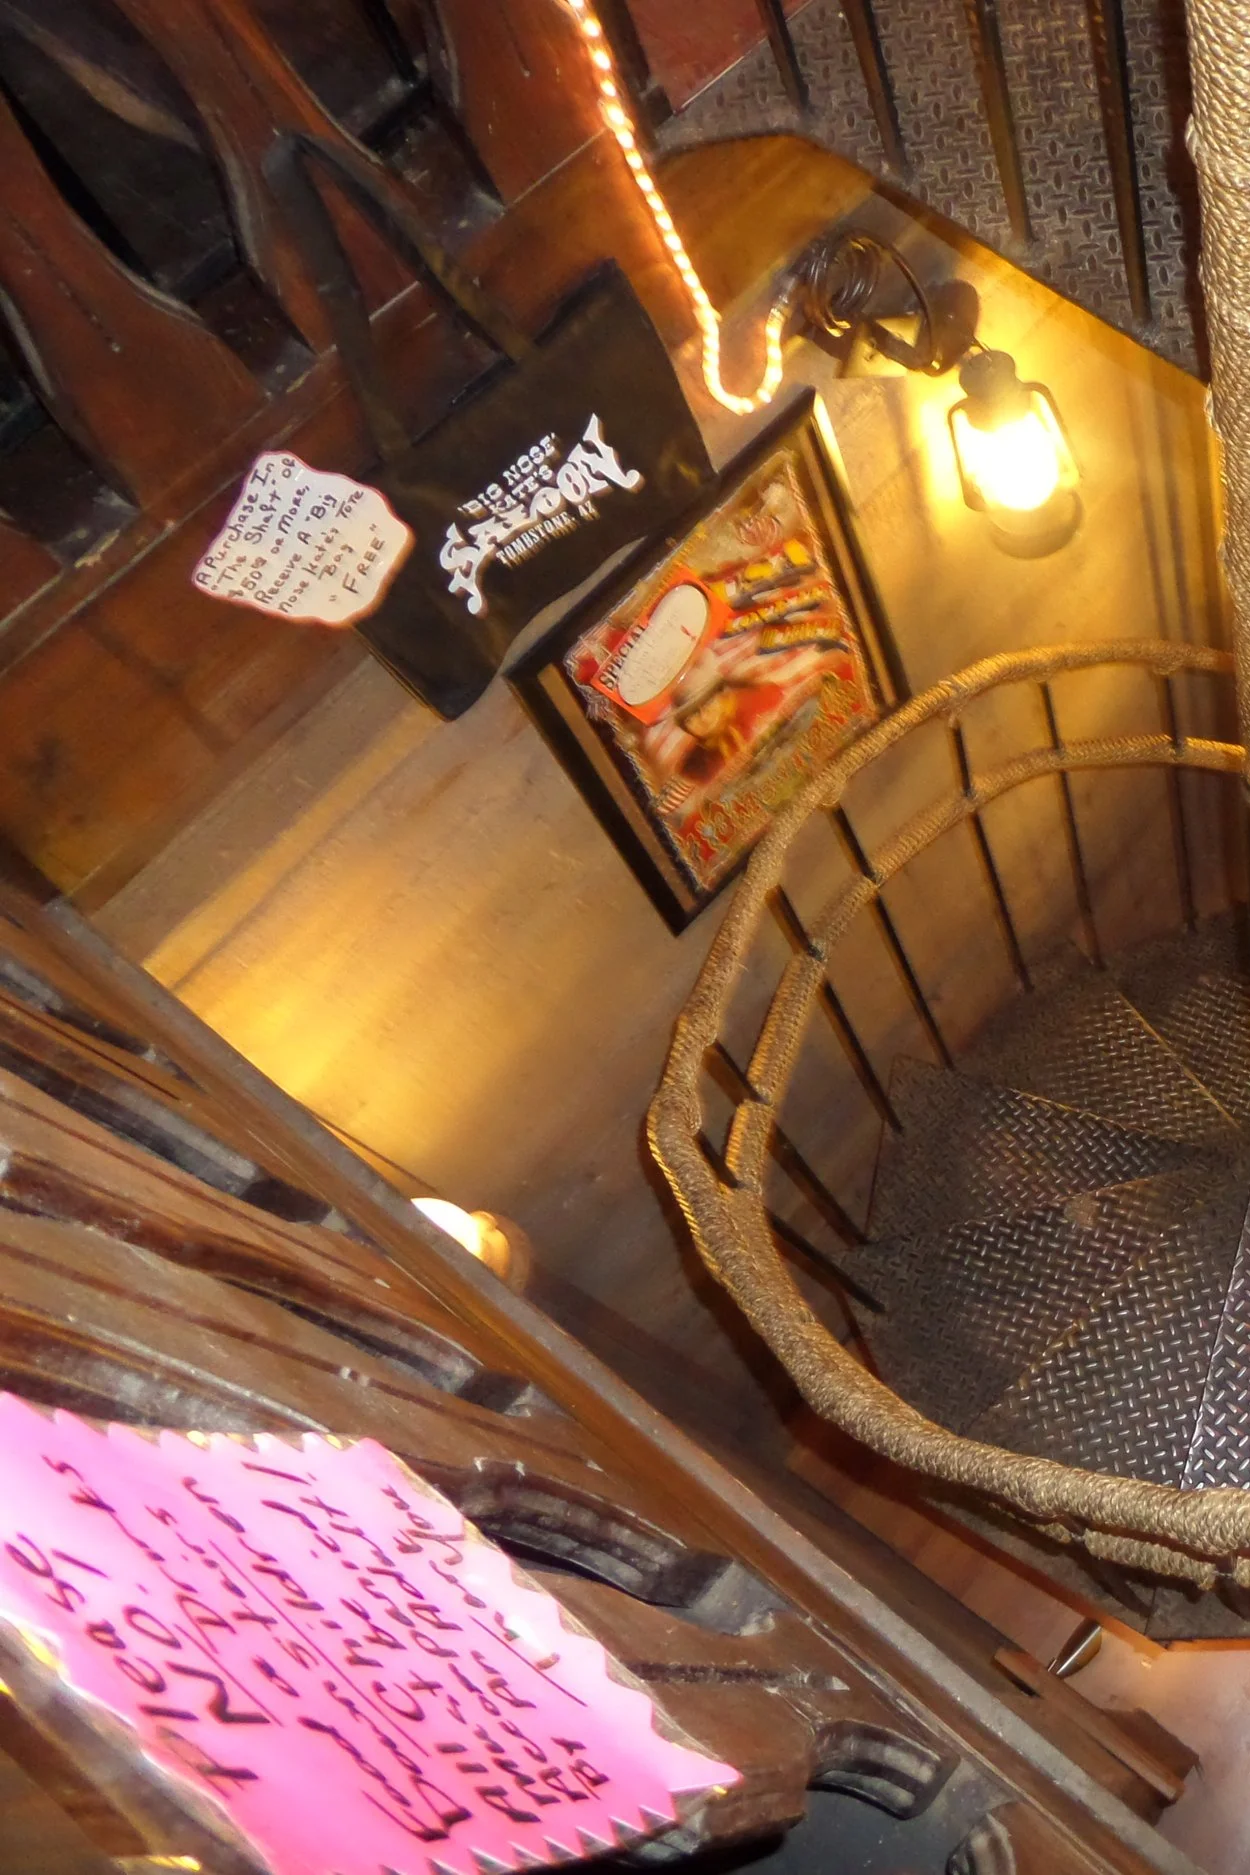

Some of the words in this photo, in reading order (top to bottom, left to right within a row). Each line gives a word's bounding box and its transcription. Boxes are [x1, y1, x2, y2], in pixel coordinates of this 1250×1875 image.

[281, 457, 296, 479] of
[439, 412, 641, 615] SALOON
[577, 500, 597, 518] AZ
[196, 571, 212, 585] A
[204, 493, 259, 569] Purchase
[250, 462, 275, 487] In
[253, 553, 302, 604] Receive
[297, 531, 312, 545] A
[317, 543, 354, 580] Bag
[597, 624, 646, 691] SPECIAL
[41, 1454, 237, 1655] Drinks
[181, 1475, 426, 1722] Children
[4, 1532, 259, 1799] Please
[144, 1504, 473, 1828] Downstairs
[258, 1502, 591, 1798] Accompanied
[339, 1595, 407, 1651] be
[465, 1647, 535, 1707] An
[299, 1715, 450, 1842] Food
[408, 1668, 560, 1805] Must
[434, 1742, 542, 1824] All
[548, 1738, 609, 1801] By
